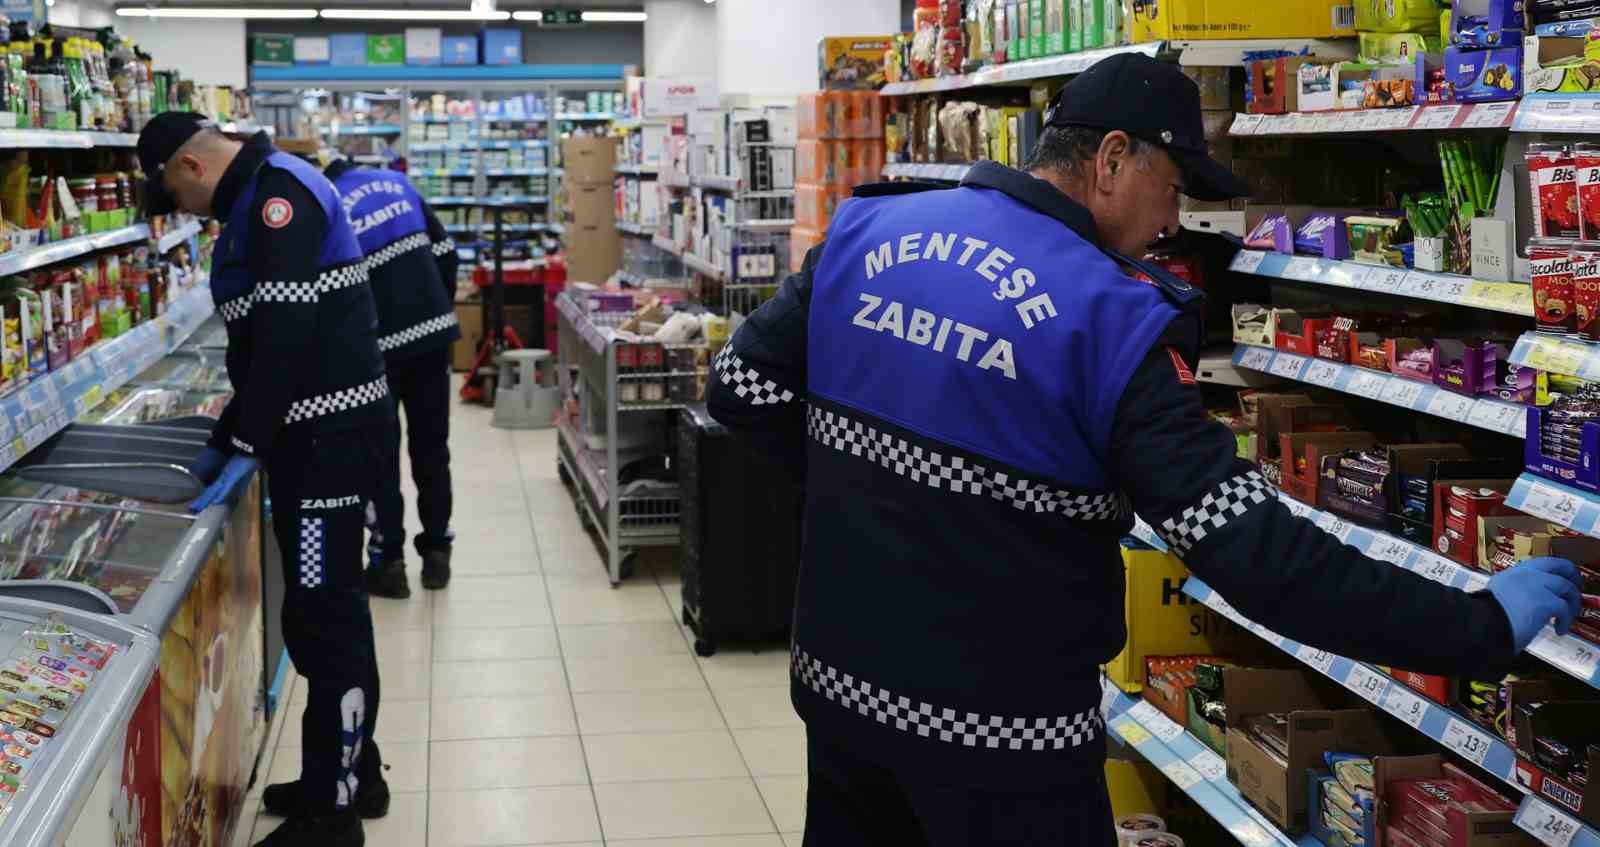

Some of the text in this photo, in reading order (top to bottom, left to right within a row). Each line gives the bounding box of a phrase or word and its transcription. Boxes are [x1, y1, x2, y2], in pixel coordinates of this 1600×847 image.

[351, 200, 413, 234] ZABITA
[1475, 254, 1500, 267] VINCE
[864, 232, 1057, 329] MENTEŞE
[851, 292, 1017, 380] ZABITA
[300, 494, 360, 509] ZABITA
[1542, 778, 1582, 810] SNICKERS
